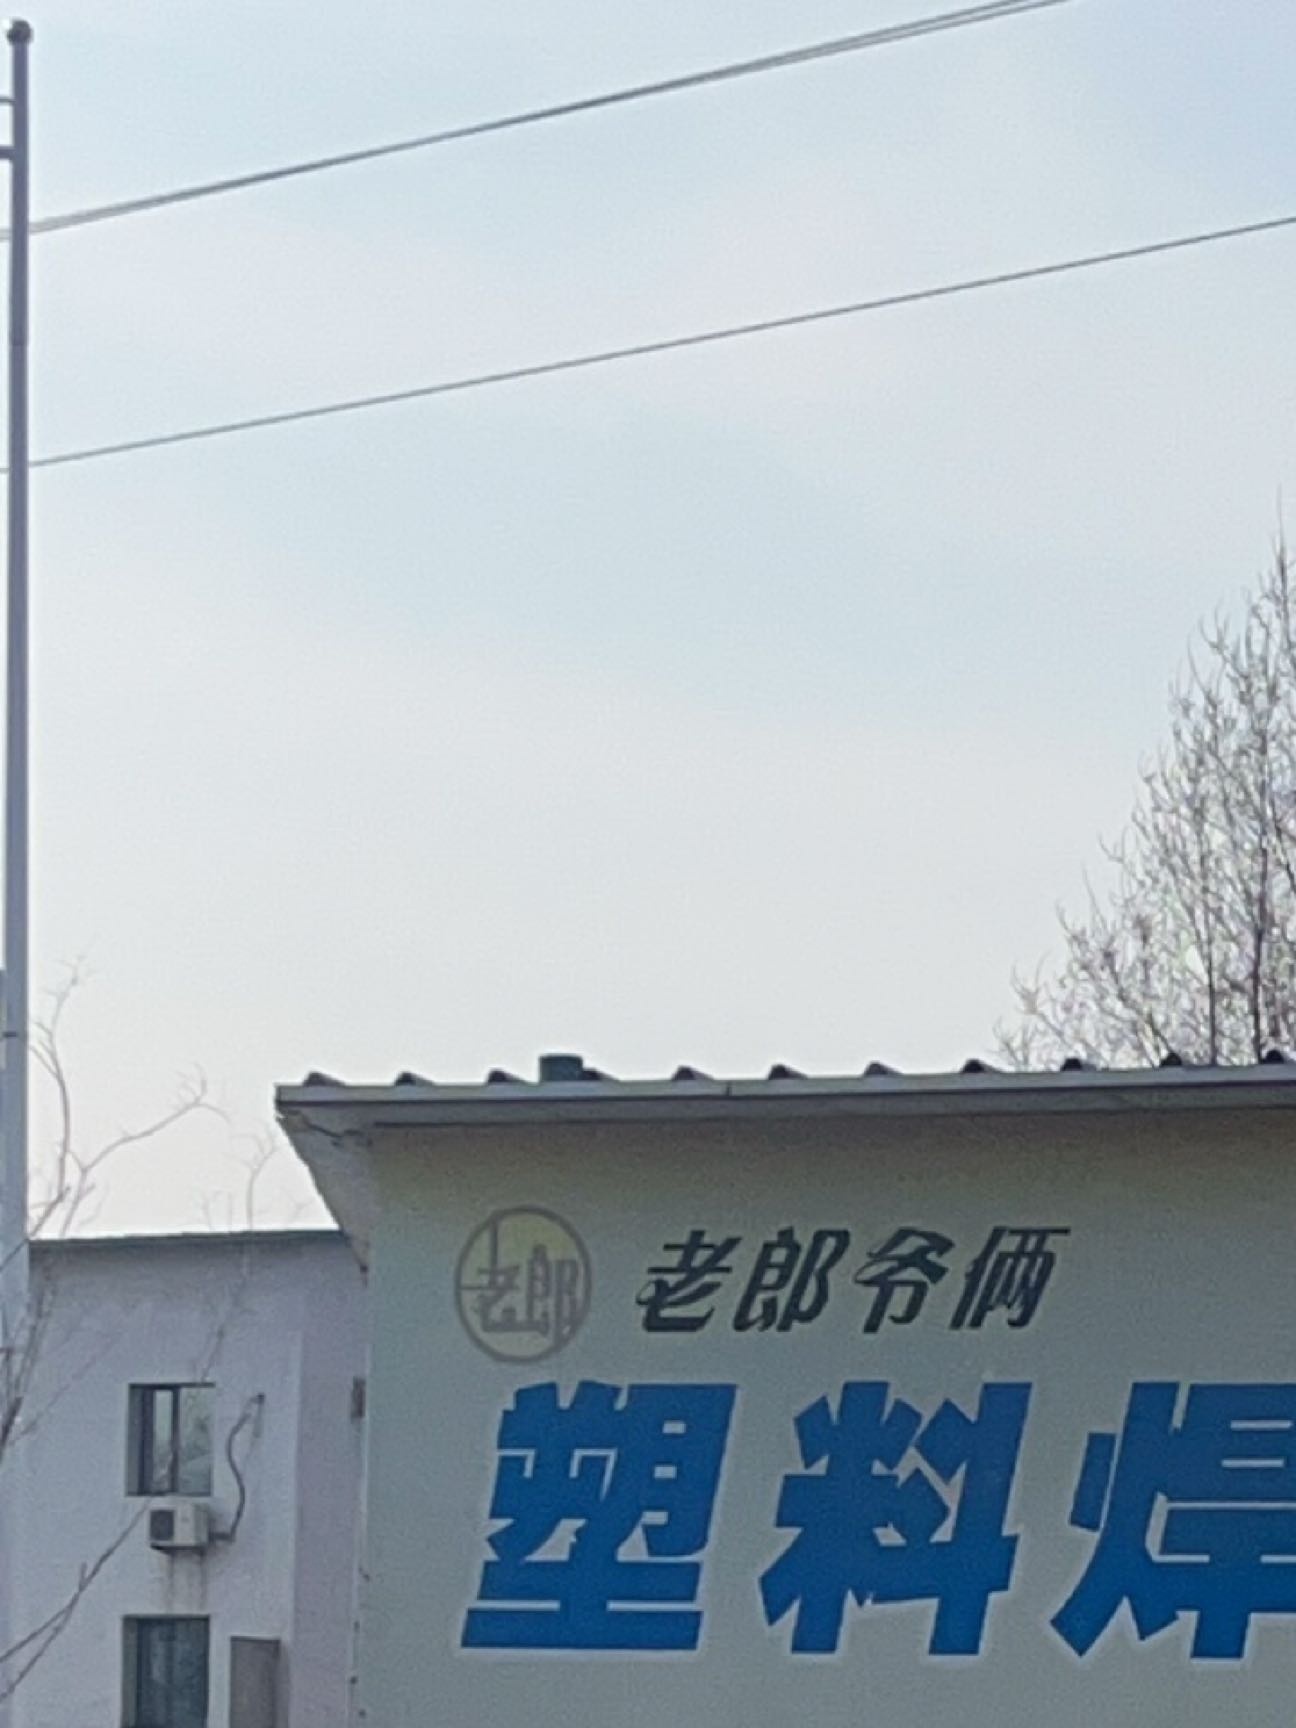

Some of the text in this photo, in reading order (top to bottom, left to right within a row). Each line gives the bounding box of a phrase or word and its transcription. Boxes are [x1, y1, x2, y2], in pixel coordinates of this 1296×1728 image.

[461, 1210, 580, 1345] 老郎
[635, 1226, 1070, 1334] 老郎爷俩
